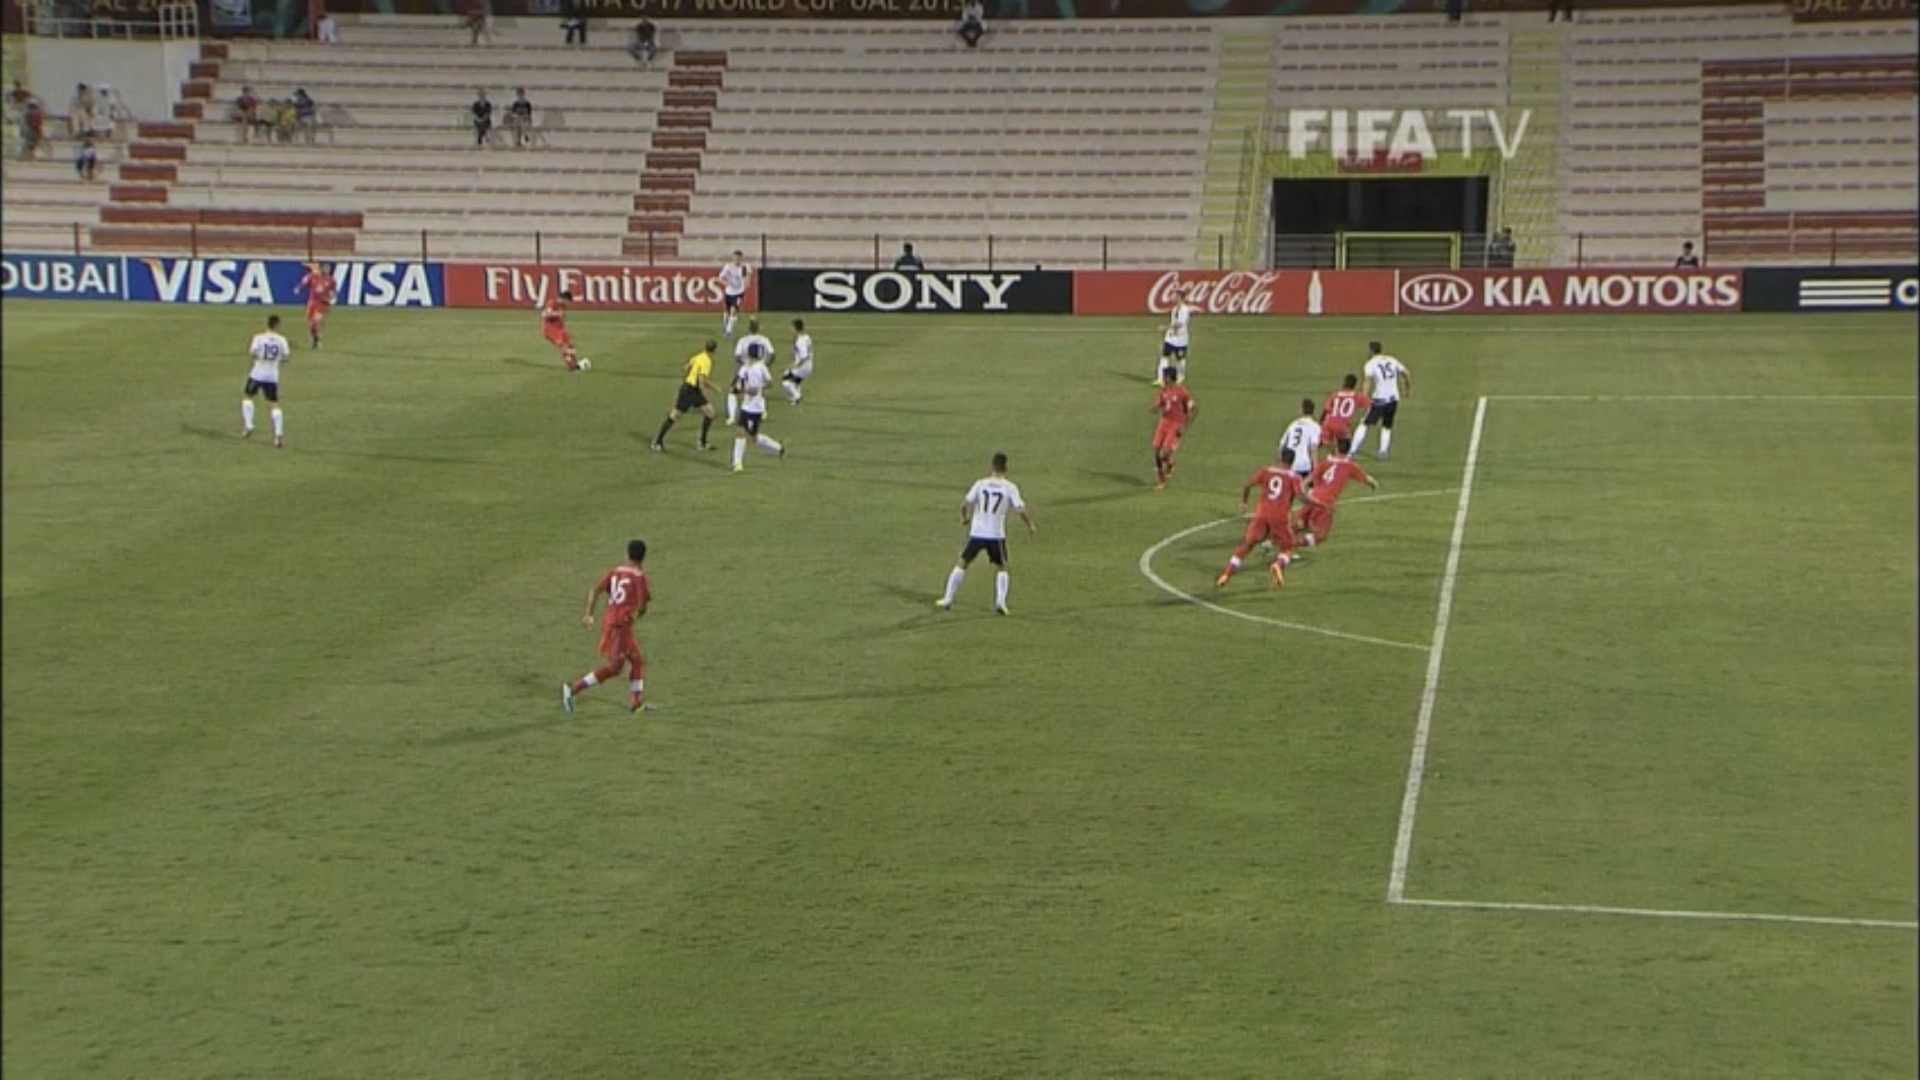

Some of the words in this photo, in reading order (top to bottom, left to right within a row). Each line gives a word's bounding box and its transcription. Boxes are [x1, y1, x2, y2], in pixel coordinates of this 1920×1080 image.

[142, 258, 274, 303] VISA
[486, 267, 549, 308] Fly
[558, 267, 723, 304] Emirates
[813, 271, 1022, 310] SONY
[1413, 281, 1460, 302] KIA
[1484, 275, 1553, 307] KIA
[1564, 274, 1740, 307] MOTORS
[263, 343, 279, 361] 19
[1377, 361, 1396, 381] 15
[1331, 397, 1355, 418] 10
[1292, 427, 1303, 447] 3
[1322, 463, 1337, 483] 4
[1267, 475, 1283, 501] 9
[981, 489, 1004, 514] 17
